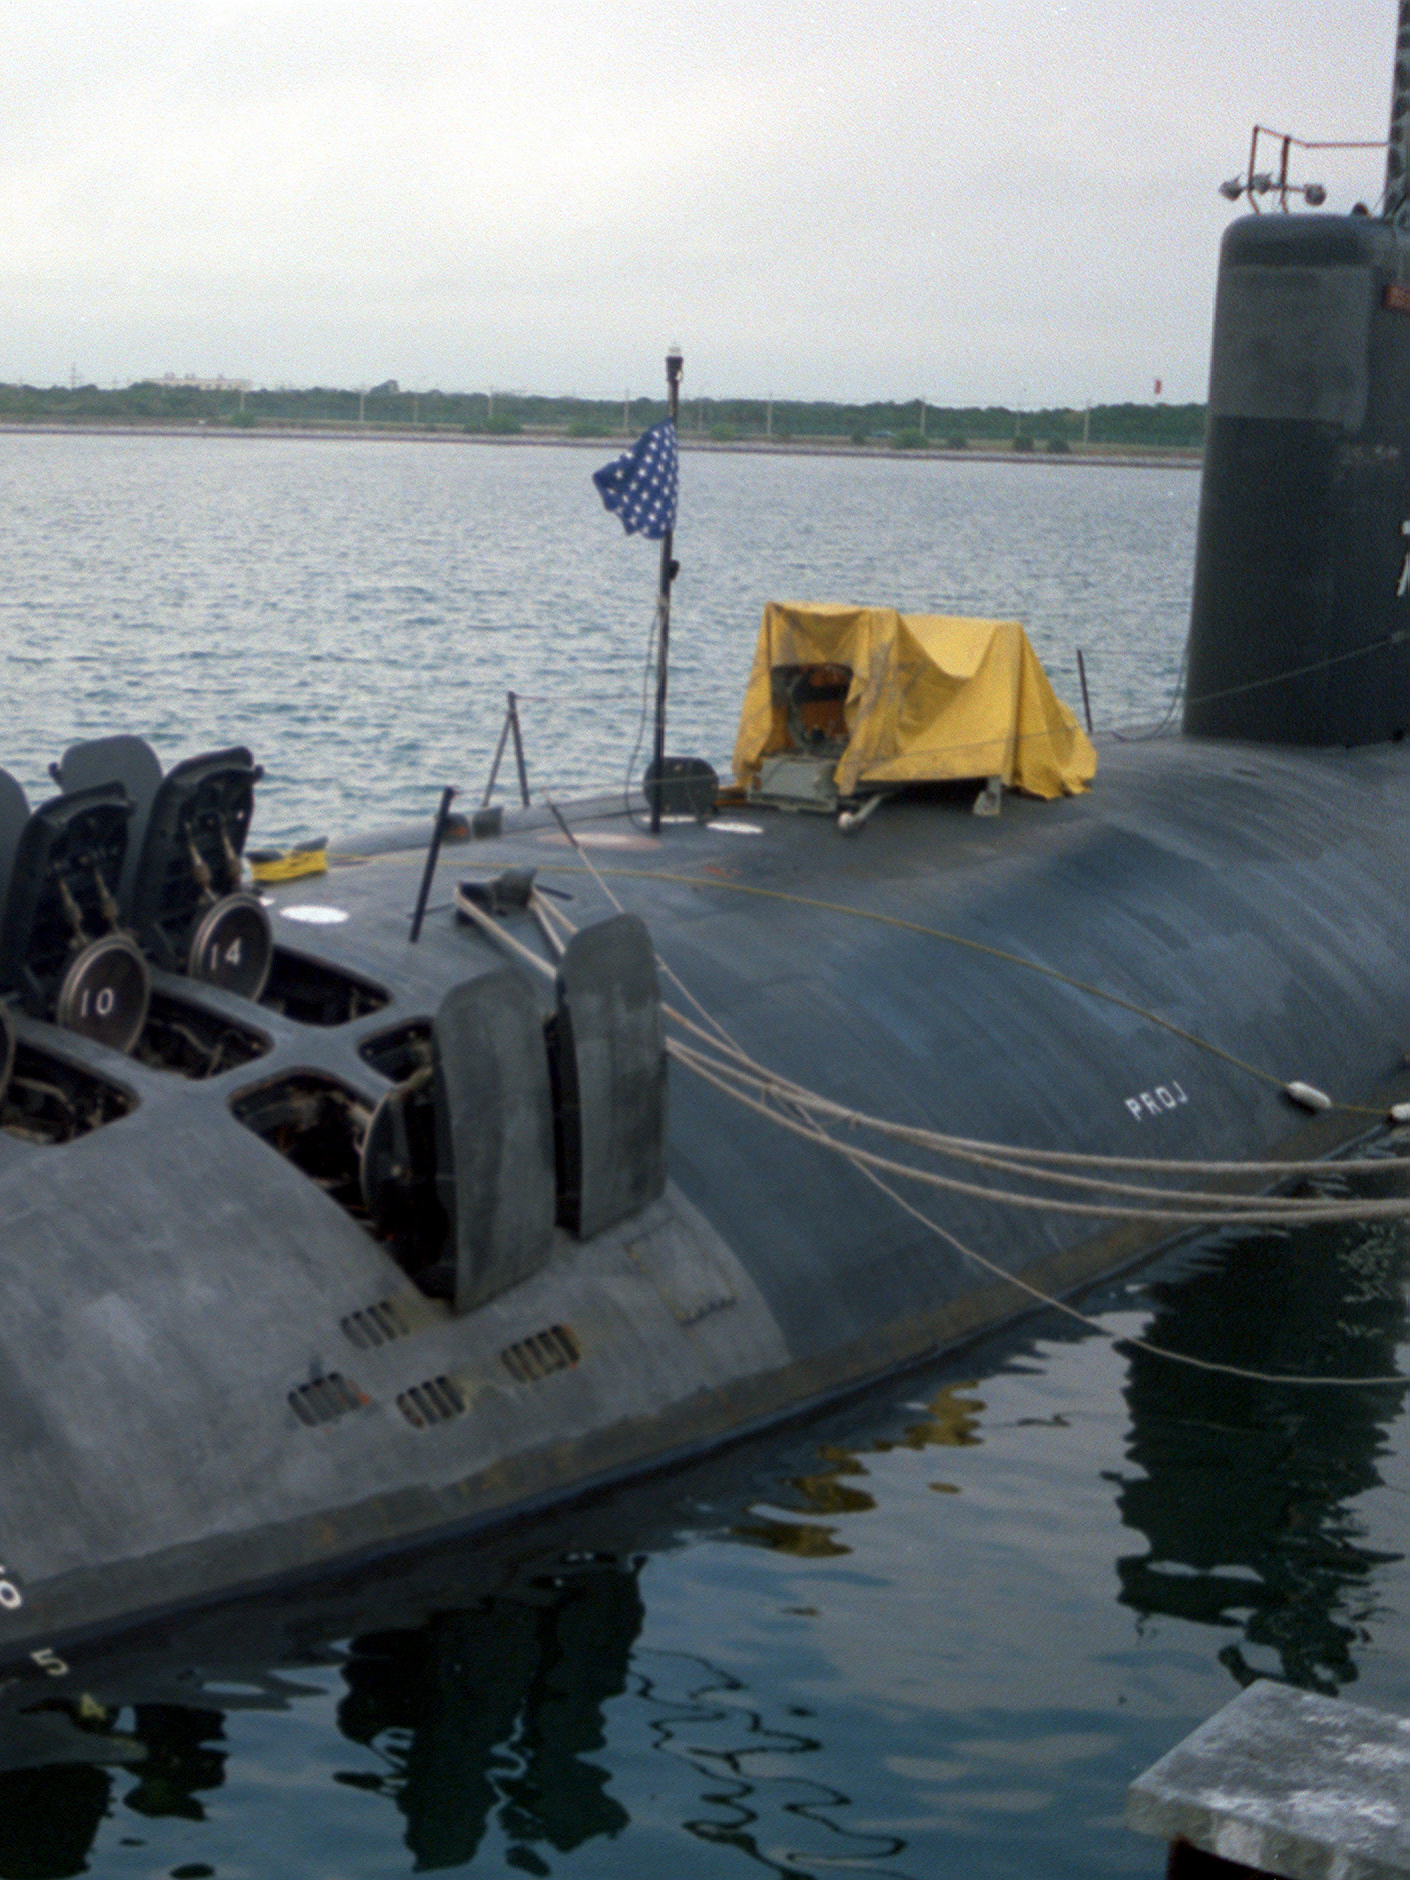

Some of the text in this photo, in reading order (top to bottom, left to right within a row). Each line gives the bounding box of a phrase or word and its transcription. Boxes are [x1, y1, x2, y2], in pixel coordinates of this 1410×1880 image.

[211, 937, 242, 970] 14
[80, 987, 115, 1017] 10
[1125, 1078, 1187, 1120] PROJ
[29, 1647, 69, 1676] 5
